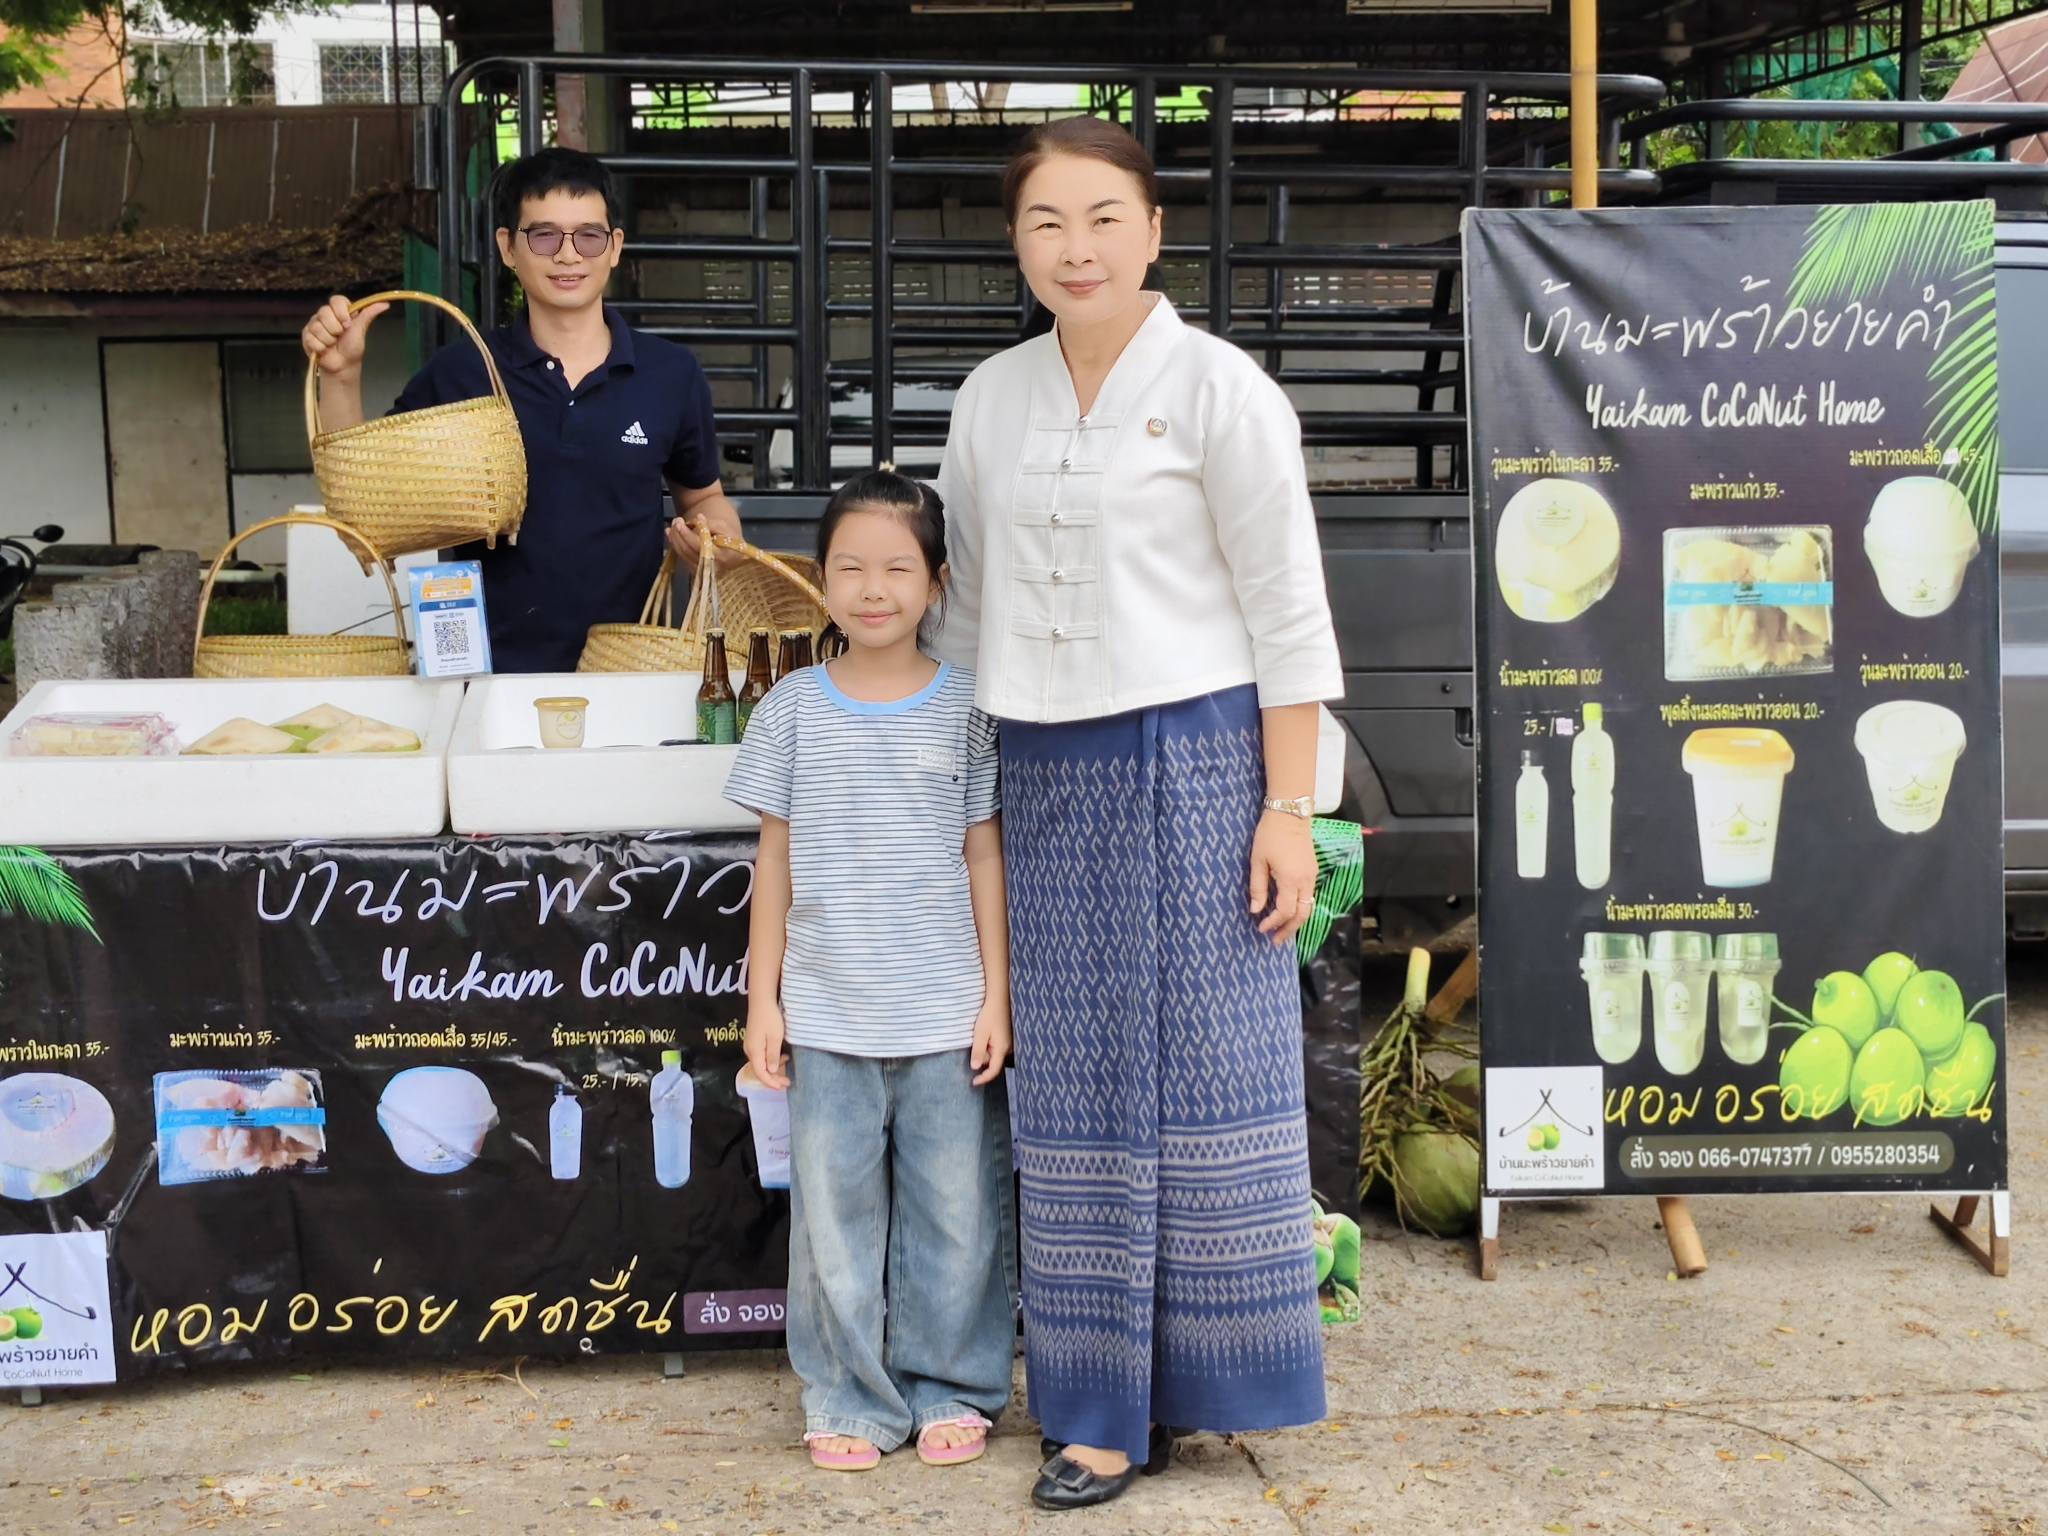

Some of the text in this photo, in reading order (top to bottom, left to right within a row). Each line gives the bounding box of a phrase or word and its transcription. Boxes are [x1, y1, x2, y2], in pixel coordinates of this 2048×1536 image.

[1586, 380, 1885, 429] Yaikam CoCoNut Home
[621, 435, 648, 445] adidas
[382, 941, 750, 1002] Yaikam CoCoNut
[169, 1023, 252, 1047] มะพร้าวแก้ว
[354, 1023, 466, 1049] มะพร้าวถอดเสื้อ
[551, 1021, 646, 1047] น้ำมะพร้าวสด
[1603, 1085, 1702, 1127] หอม
[1716, 1049, 1840, 1122] อร่อย
[1630, 1137, 1653, 1168] สั่ง
[1659, 1151, 1694, 1168] จอง
[1698, 1144, 1812, 1168] 066-0747377
[1831, 1145, 1940, 1166] 0955280354
[130, 1255, 785, 1355] หอม อร่อย สดชื่น สั่ง จอง
[54, 1366, 83, 1377] Home
